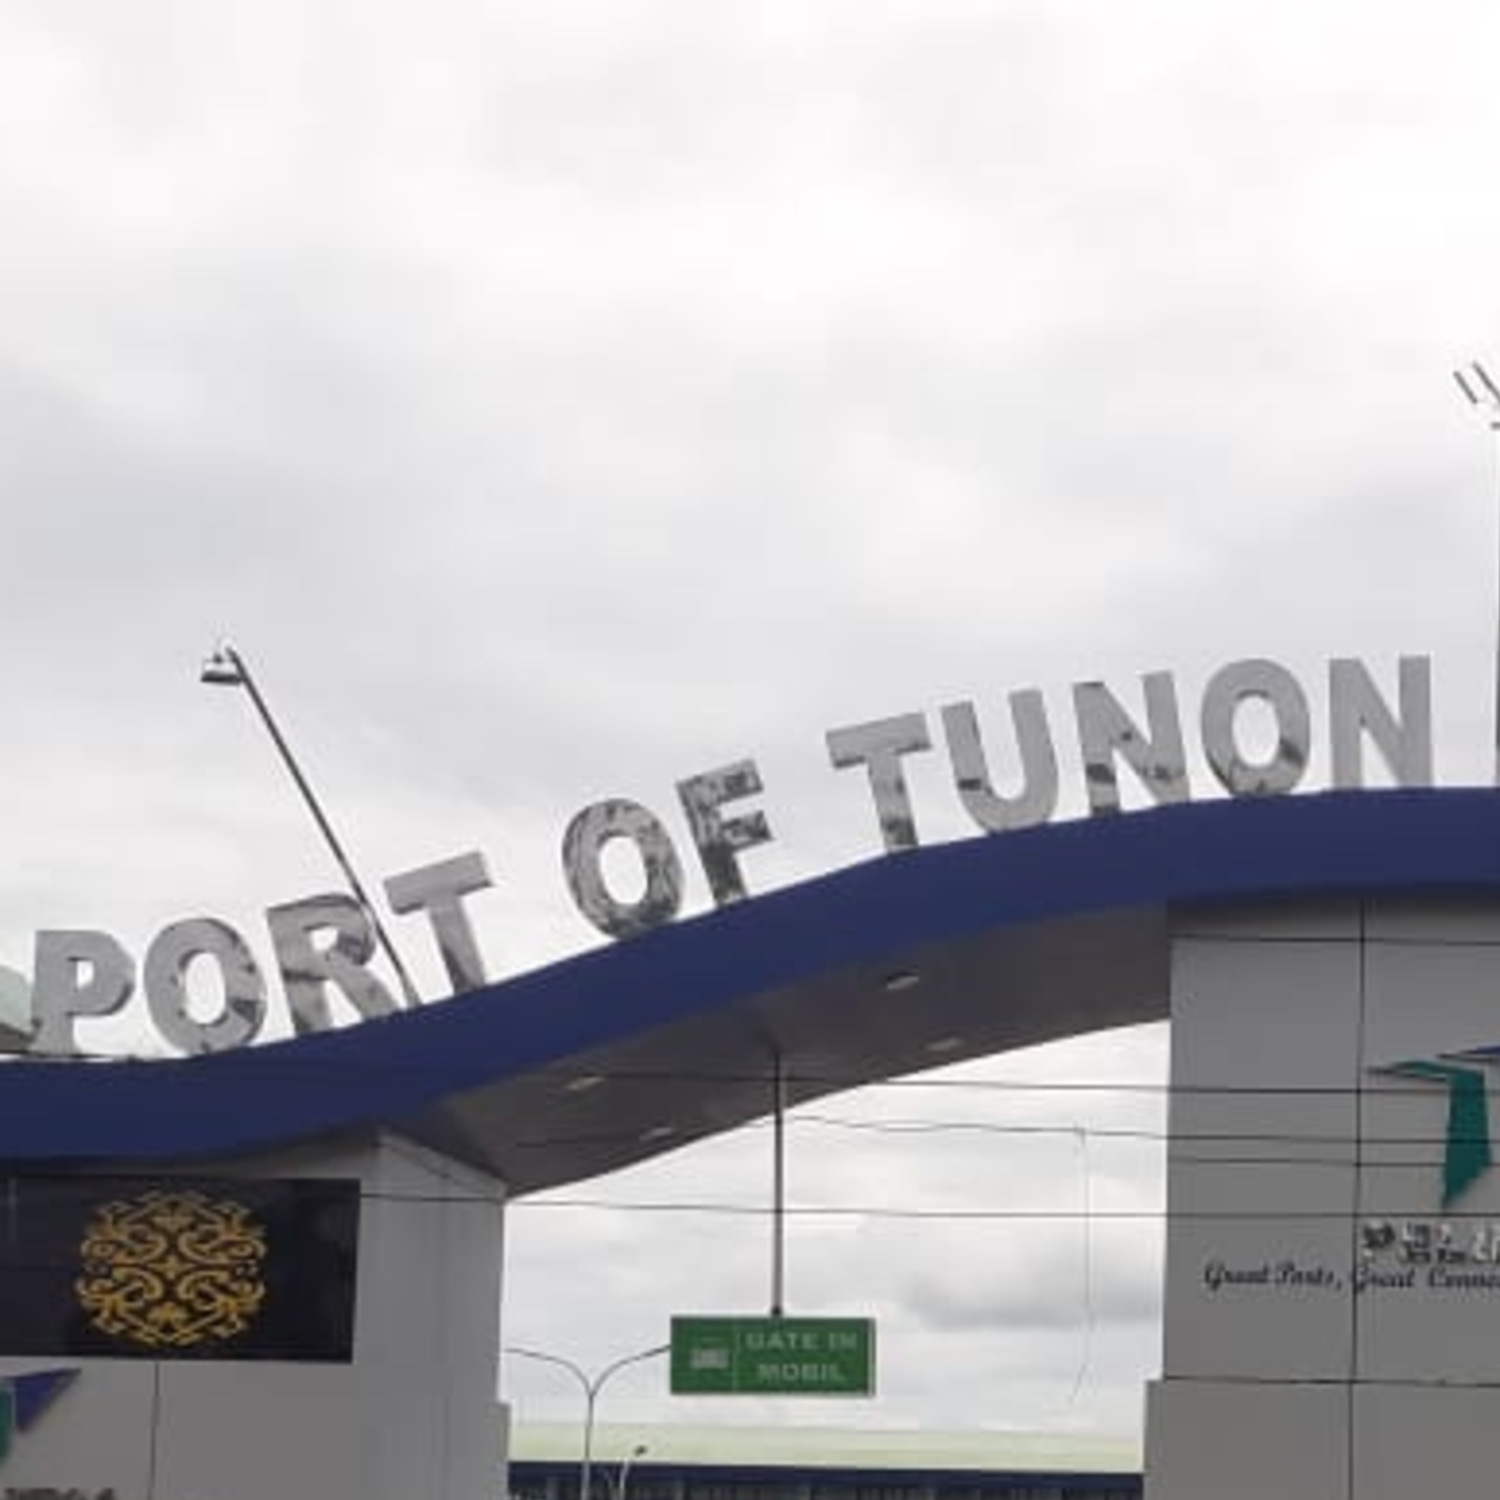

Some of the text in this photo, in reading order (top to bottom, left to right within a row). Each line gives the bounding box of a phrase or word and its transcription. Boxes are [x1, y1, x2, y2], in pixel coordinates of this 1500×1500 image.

[29, 850, 496, 1055] PORT
[560, 758, 776, 941] OF
[824, 654, 1433, 854] TUNON
[744, 1331, 821, 1350] GATE
[757, 1362, 847, 1383] MOBIL
